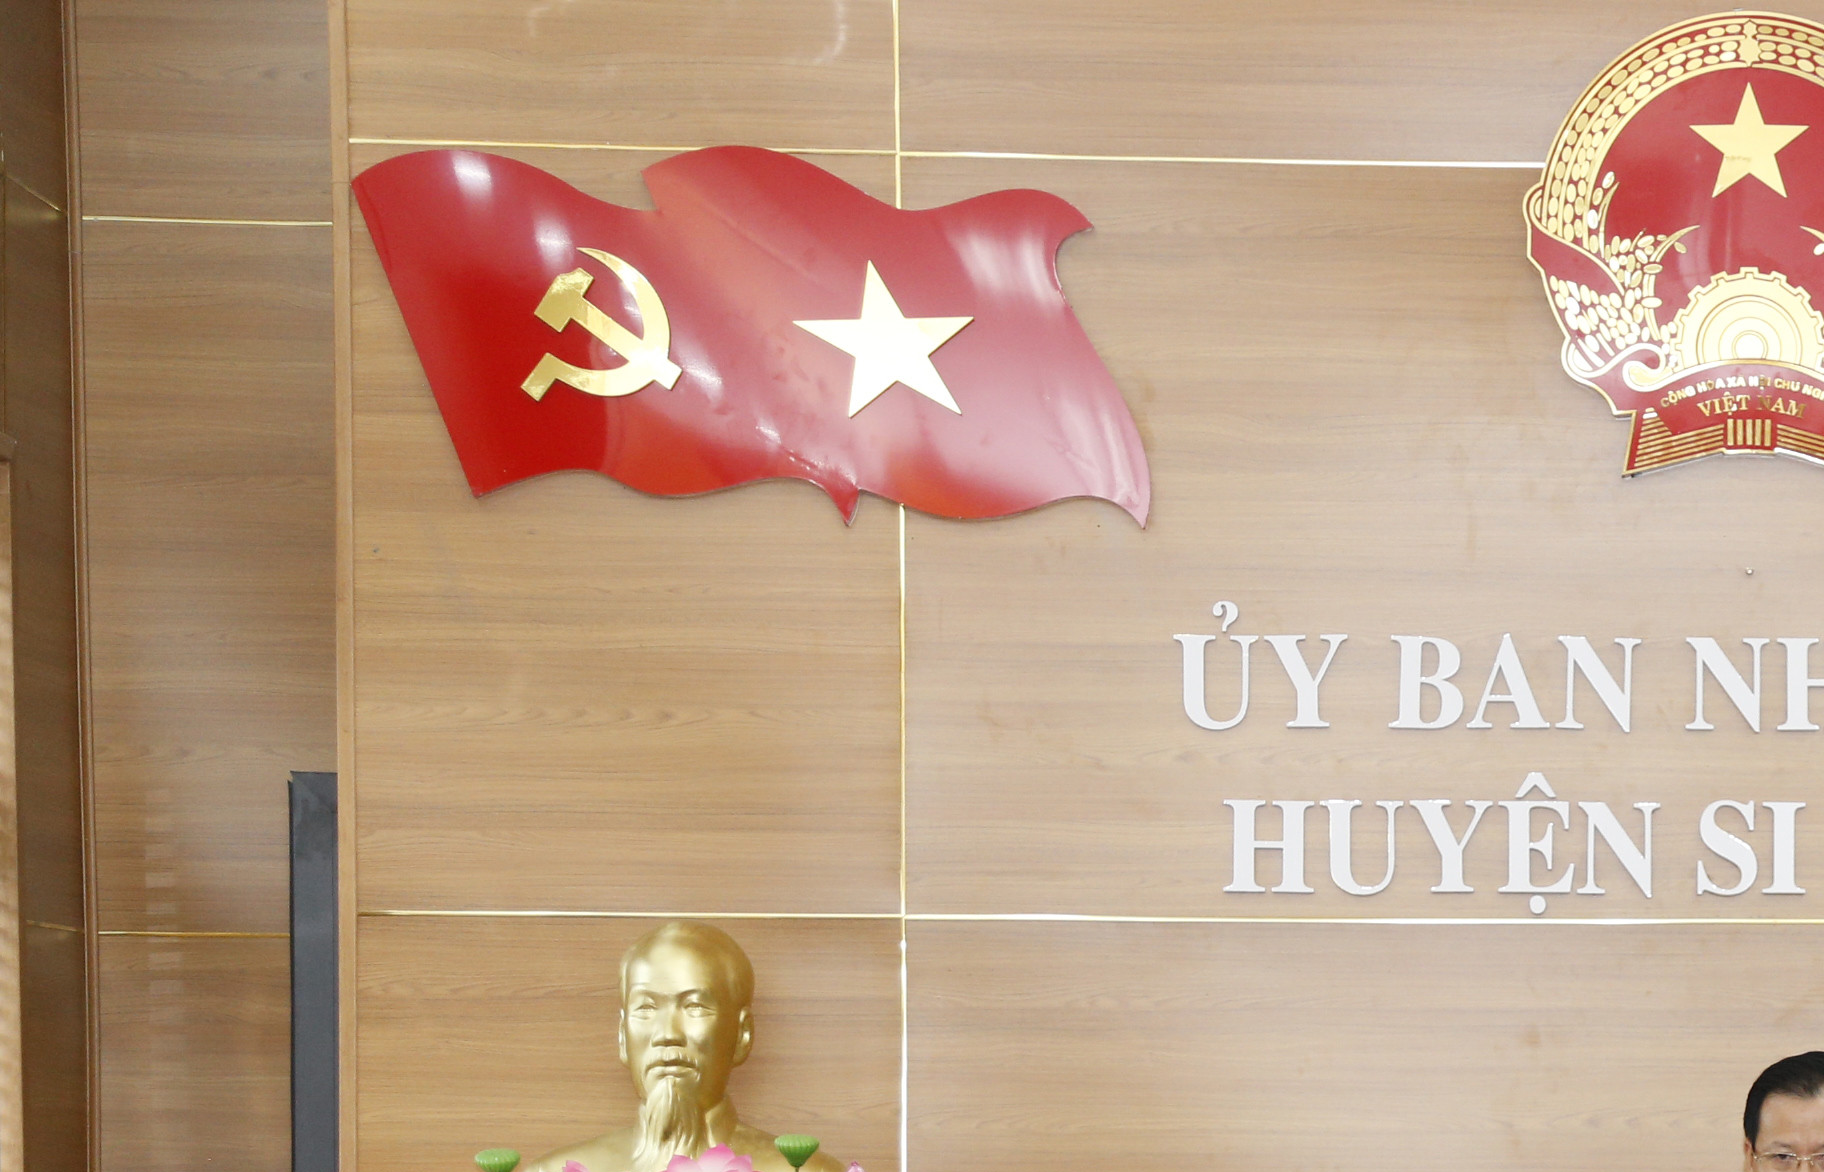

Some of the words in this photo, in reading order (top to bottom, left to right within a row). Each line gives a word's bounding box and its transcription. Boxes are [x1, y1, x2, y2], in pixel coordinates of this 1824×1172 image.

[1696, 391, 1751, 417] VIỆT
[1756, 394, 1807, 419] NAM
[1172, 600, 1349, 731] ỦY
[1387, 632, 1643, 734] BAN
[1222, 771, 1661, 916] HUYỆN
[1696, 799, 1807, 897] SI
